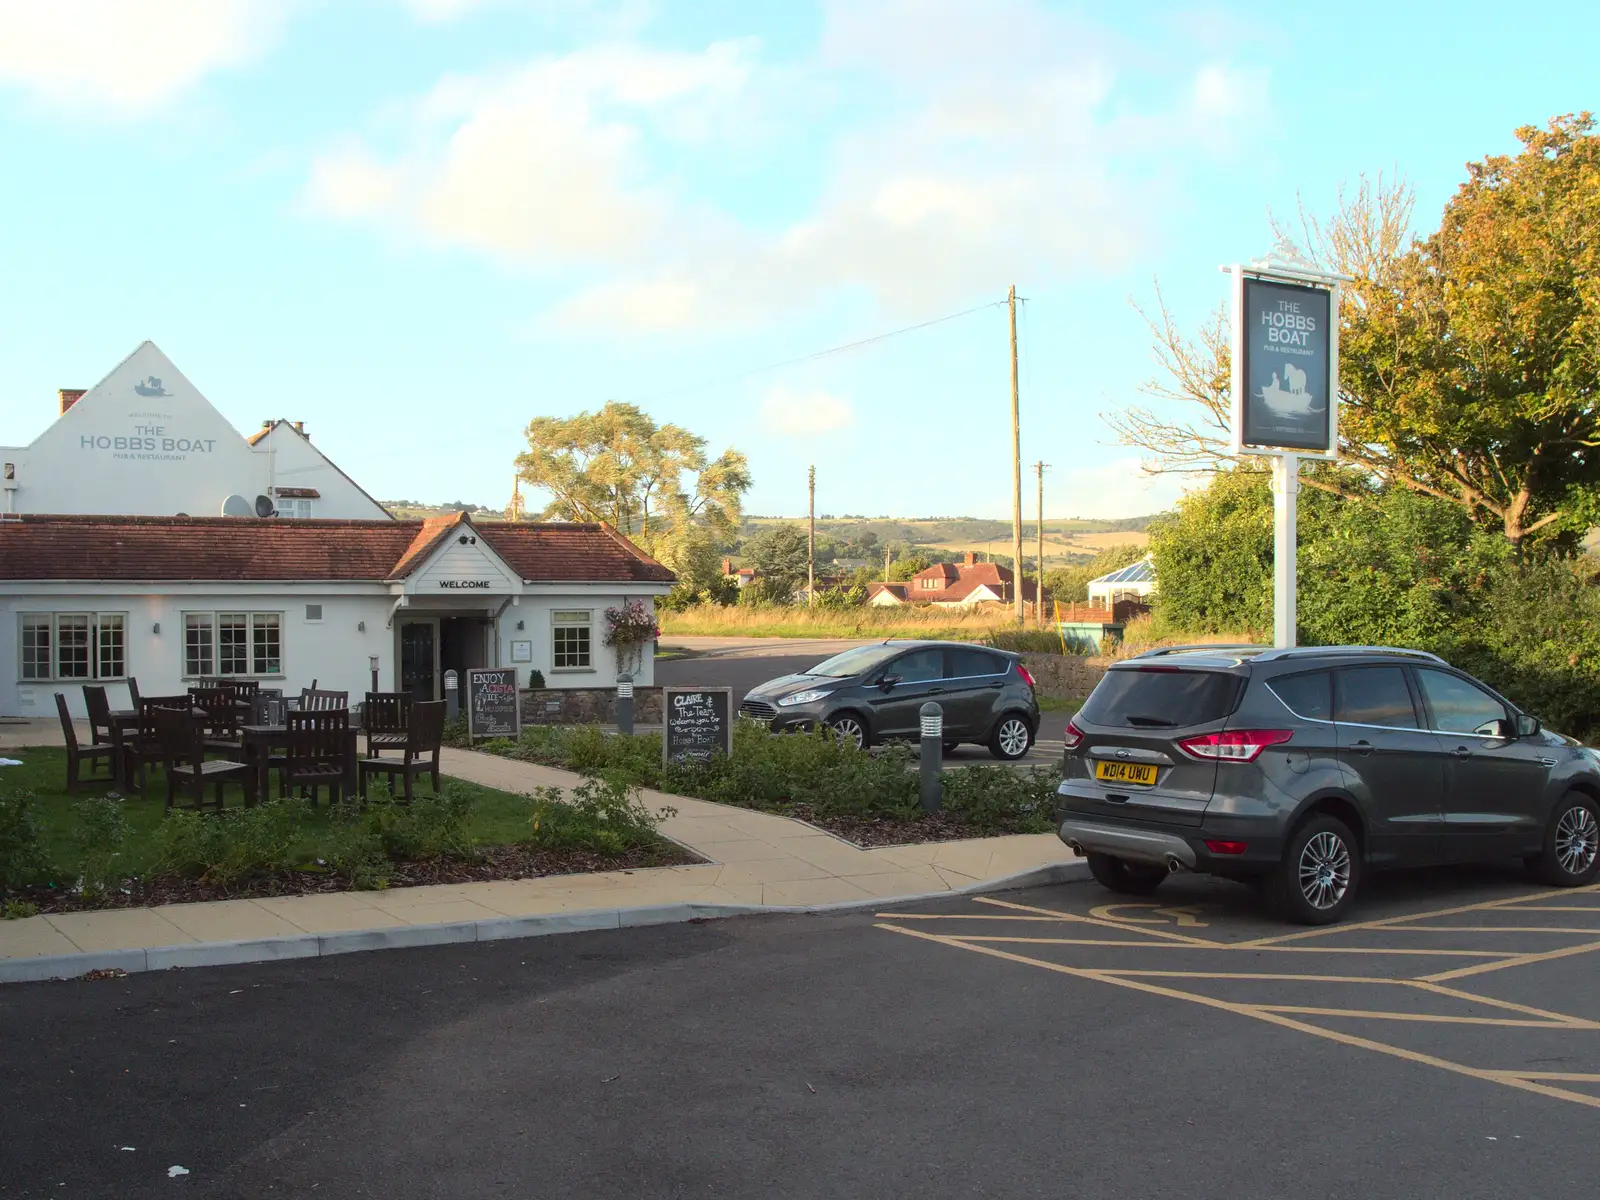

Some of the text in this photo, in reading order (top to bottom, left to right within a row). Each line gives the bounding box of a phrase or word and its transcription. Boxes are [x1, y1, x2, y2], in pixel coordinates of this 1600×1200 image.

[1277, 300, 1301, 314] THE
[1261, 311, 1316, 331] HOBBS
[1268, 327, 1309, 346] BOAT
[1280, 346, 1314, 357] RESTAURANT
[134, 425, 166, 437] THE
[80, 435, 217, 453] HOBBS BOAT
[137, 453, 187, 461] RESTAURANT
[440, 580, 490, 589] WELCOME
[473, 673, 505, 684] ENJOY
[480, 683, 488, 693] A
[674, 693, 704, 707] CLAIRE
[675, 707, 694, 718] The
[1103, 763, 1150, 781] WD14 UWU
